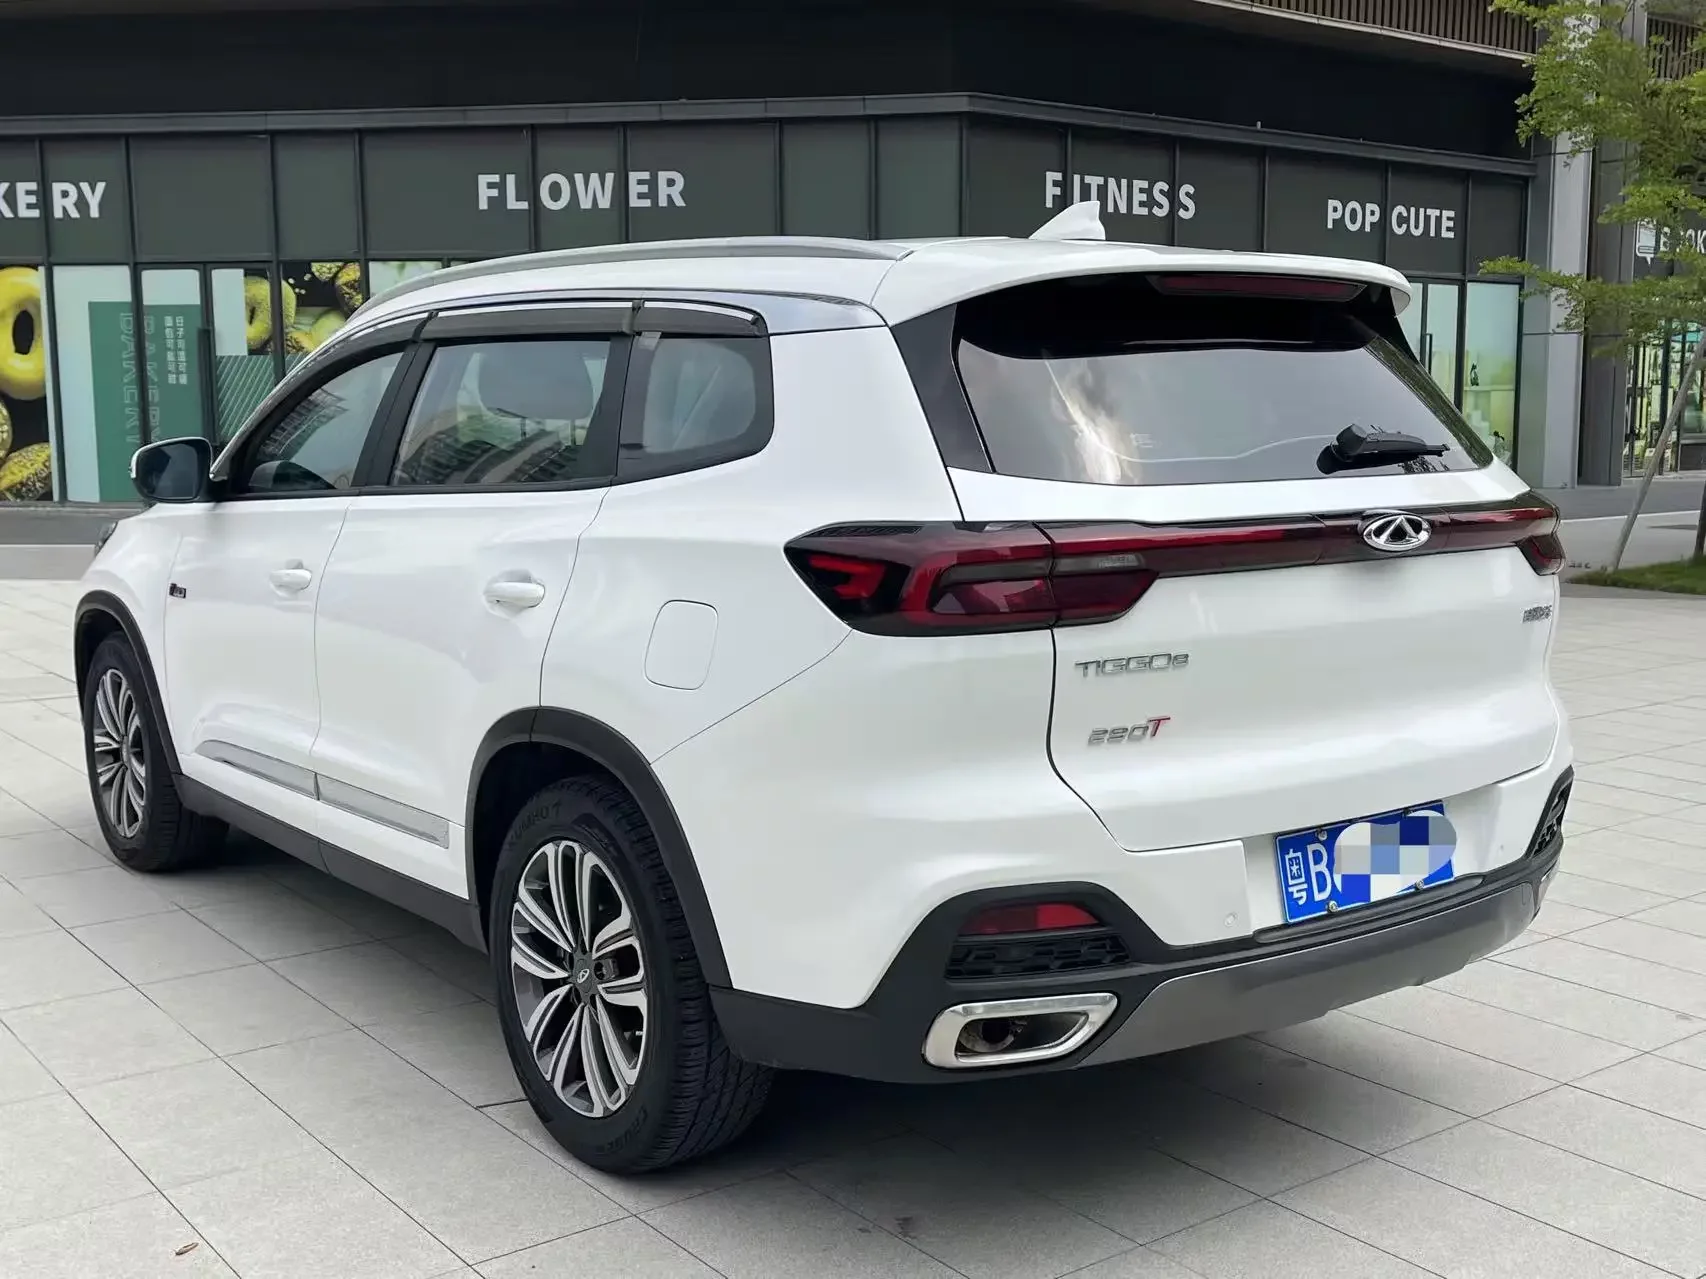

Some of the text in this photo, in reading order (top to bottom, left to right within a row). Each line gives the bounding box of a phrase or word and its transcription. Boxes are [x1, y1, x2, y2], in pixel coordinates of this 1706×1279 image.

[477, 170, 687, 211] FLOWER
[1045, 171, 1196, 220] FITNESS
[1327, 199, 1456, 239] POP CUTE
